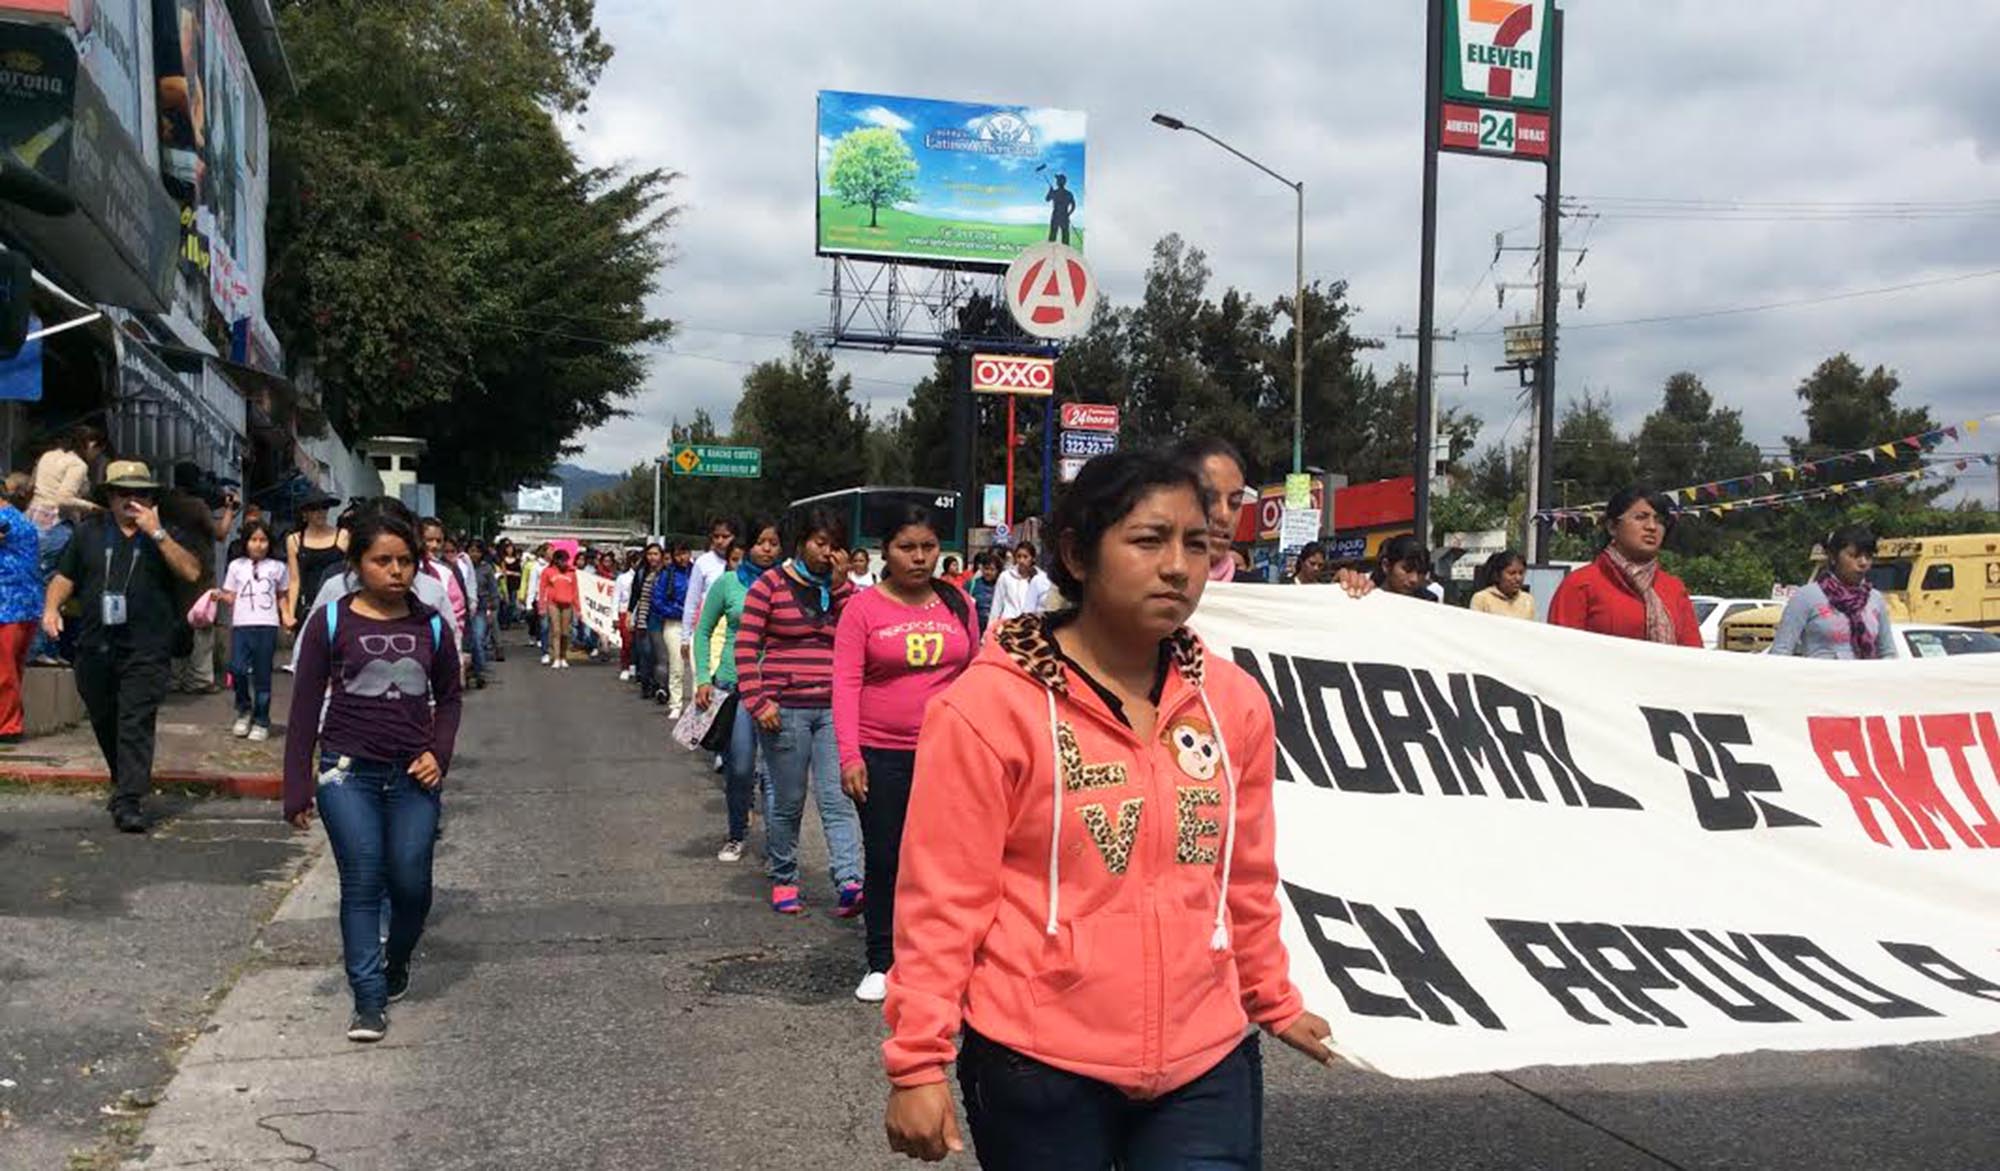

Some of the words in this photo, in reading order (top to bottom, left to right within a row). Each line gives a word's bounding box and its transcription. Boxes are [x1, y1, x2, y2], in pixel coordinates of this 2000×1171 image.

[1480, 114, 1514, 148] 24
[977, 361, 1050, 388] OXXO
[1069, 408, 1087, 426] 24
[934, 496, 954, 509] 431
[240, 577, 274, 612] 43
[905, 633, 944, 668] 87
[1231, 646, 1645, 811] NORMAL
[1638, 706, 1822, 832] DE
[1281, 880, 1508, 1030] EN
[1484, 917, 1947, 1028] APOYO
